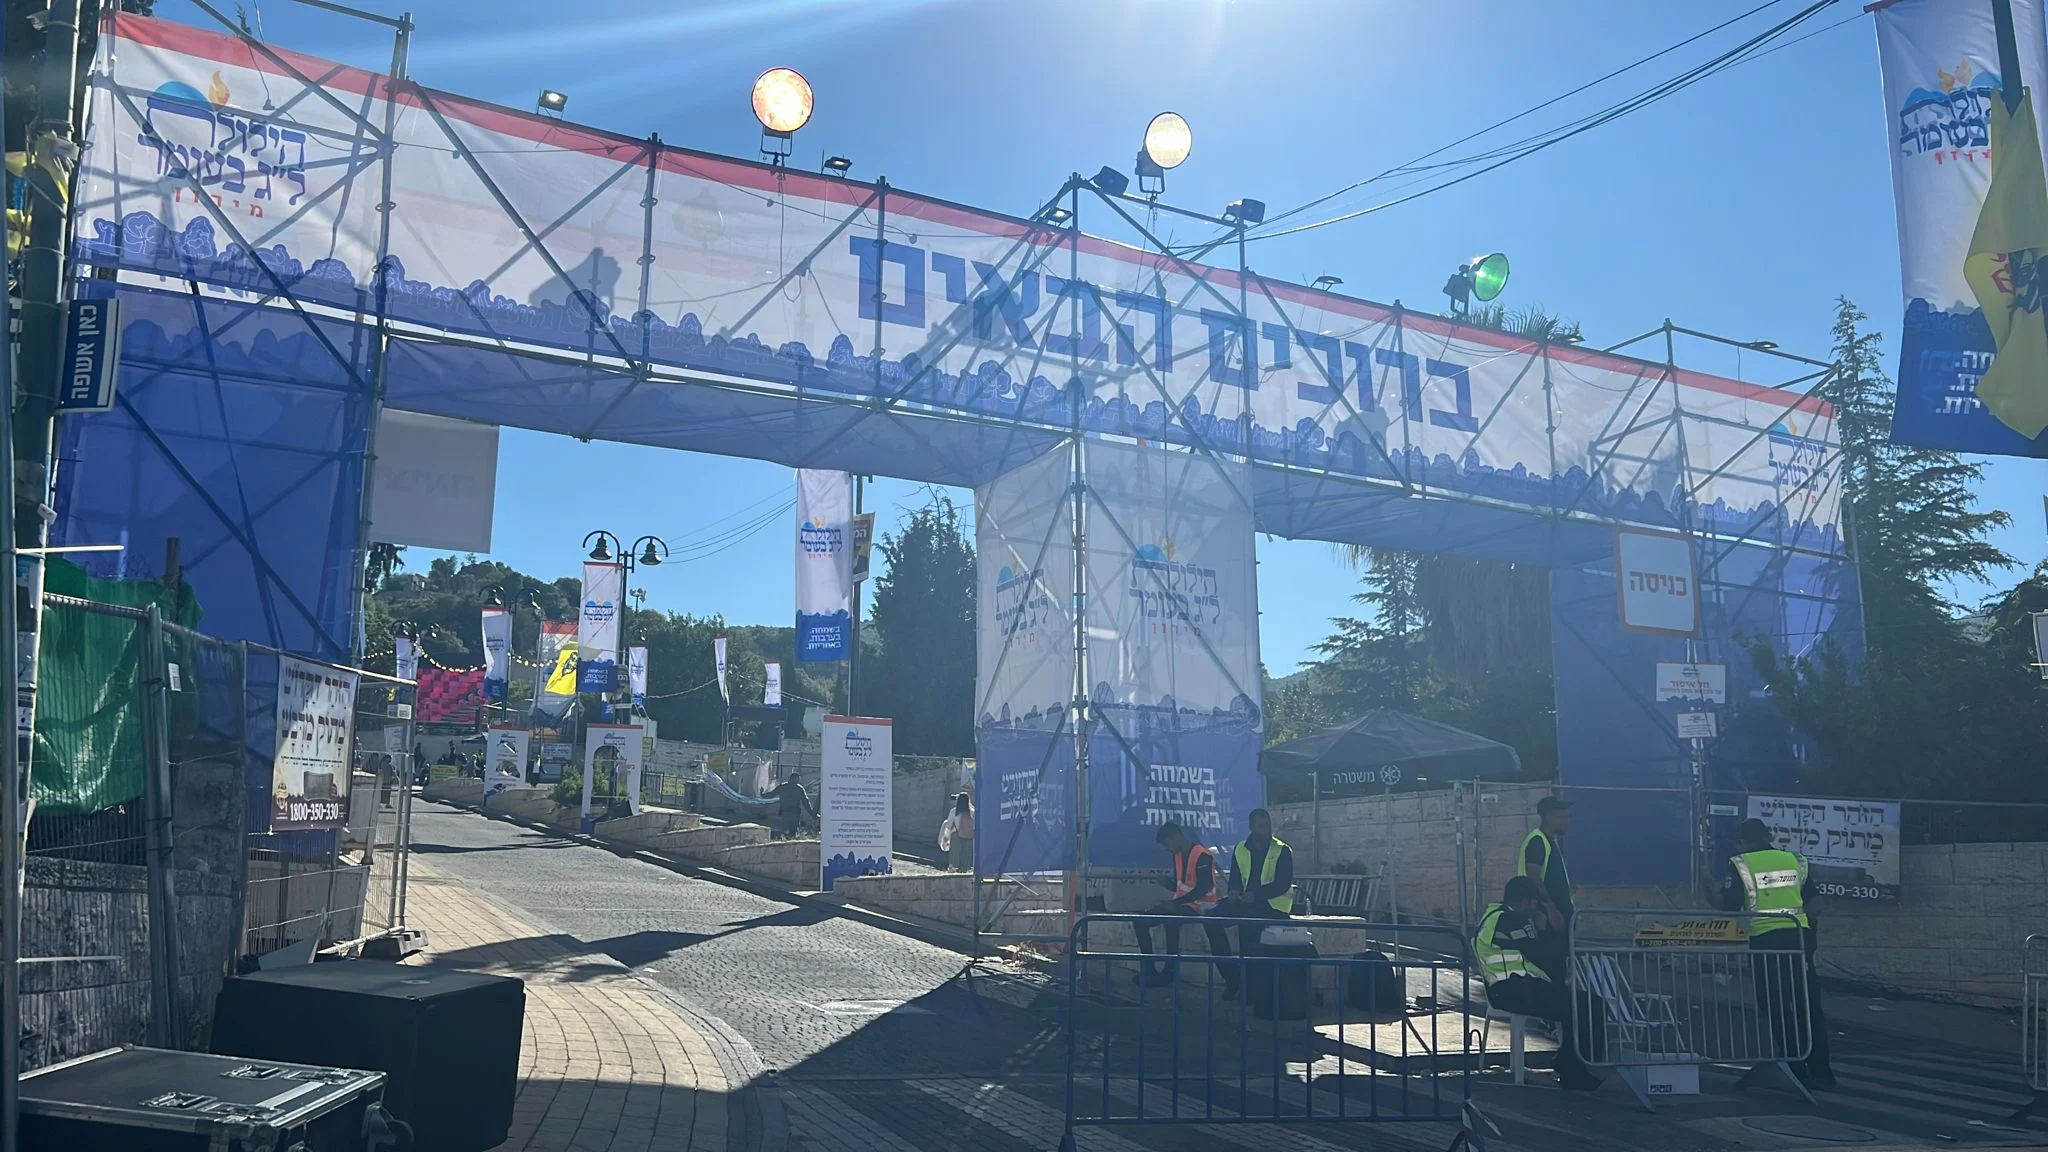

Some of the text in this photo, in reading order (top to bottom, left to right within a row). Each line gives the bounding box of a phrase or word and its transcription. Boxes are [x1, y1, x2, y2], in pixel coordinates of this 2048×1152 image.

[147, 97, 306, 172] הילולת
[138, 139, 246, 193] בעומר
[174, 186, 264, 218] מירון
[849, 235, 1173, 373] הבאים
[71, 304, 100, 399] כאן אשפה
[1200, 307, 1479, 433] ברוכים
[1132, 558, 1217, 596] הילולת
[1629, 571, 1687, 597] כניסה
[1145, 764, 1215, 785] בשמחה.
[1333, 770, 1376, 785] משטרה
[289, 802, 339, 821] 1800-350-330
[1144, 786, 1217, 807] בערבות.
[1140, 807, 1221, 829] באחריות.
